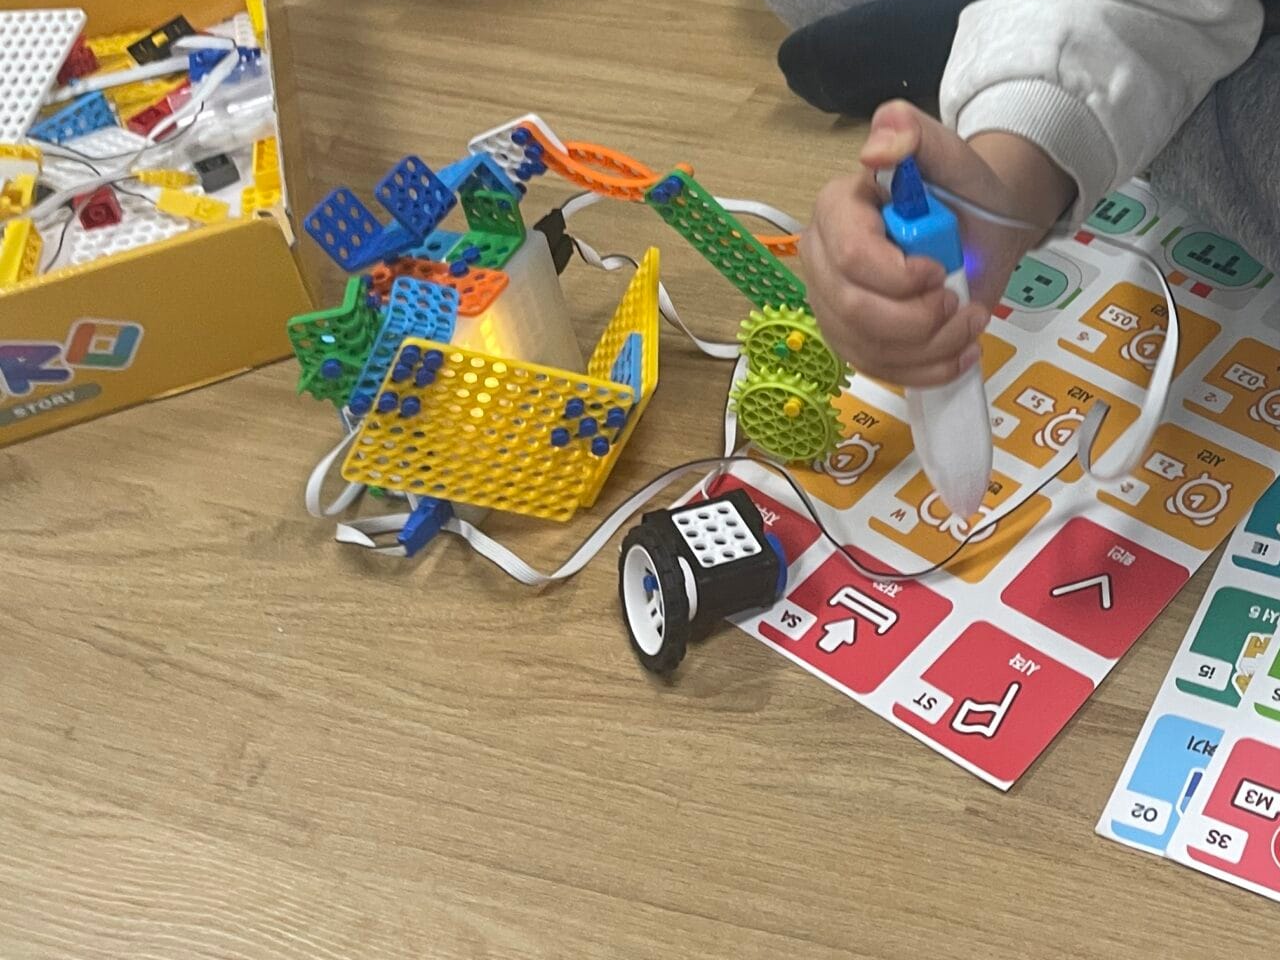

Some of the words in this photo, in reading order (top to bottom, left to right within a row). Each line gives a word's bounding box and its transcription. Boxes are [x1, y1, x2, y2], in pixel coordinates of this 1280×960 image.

[12, 390, 77, 418] STORY
[890, 508, 907, 522] W
[781, 609, 802, 630] SA
[1249, 605, 1261, 618] 5
[1009, 652, 1040, 677] 시작
[1198, 664, 1217, 679] i5
[912, 691, 937, 711] ST
[1244, 788, 1274, 811] M3
[1206, 829, 1232, 850] 3S
